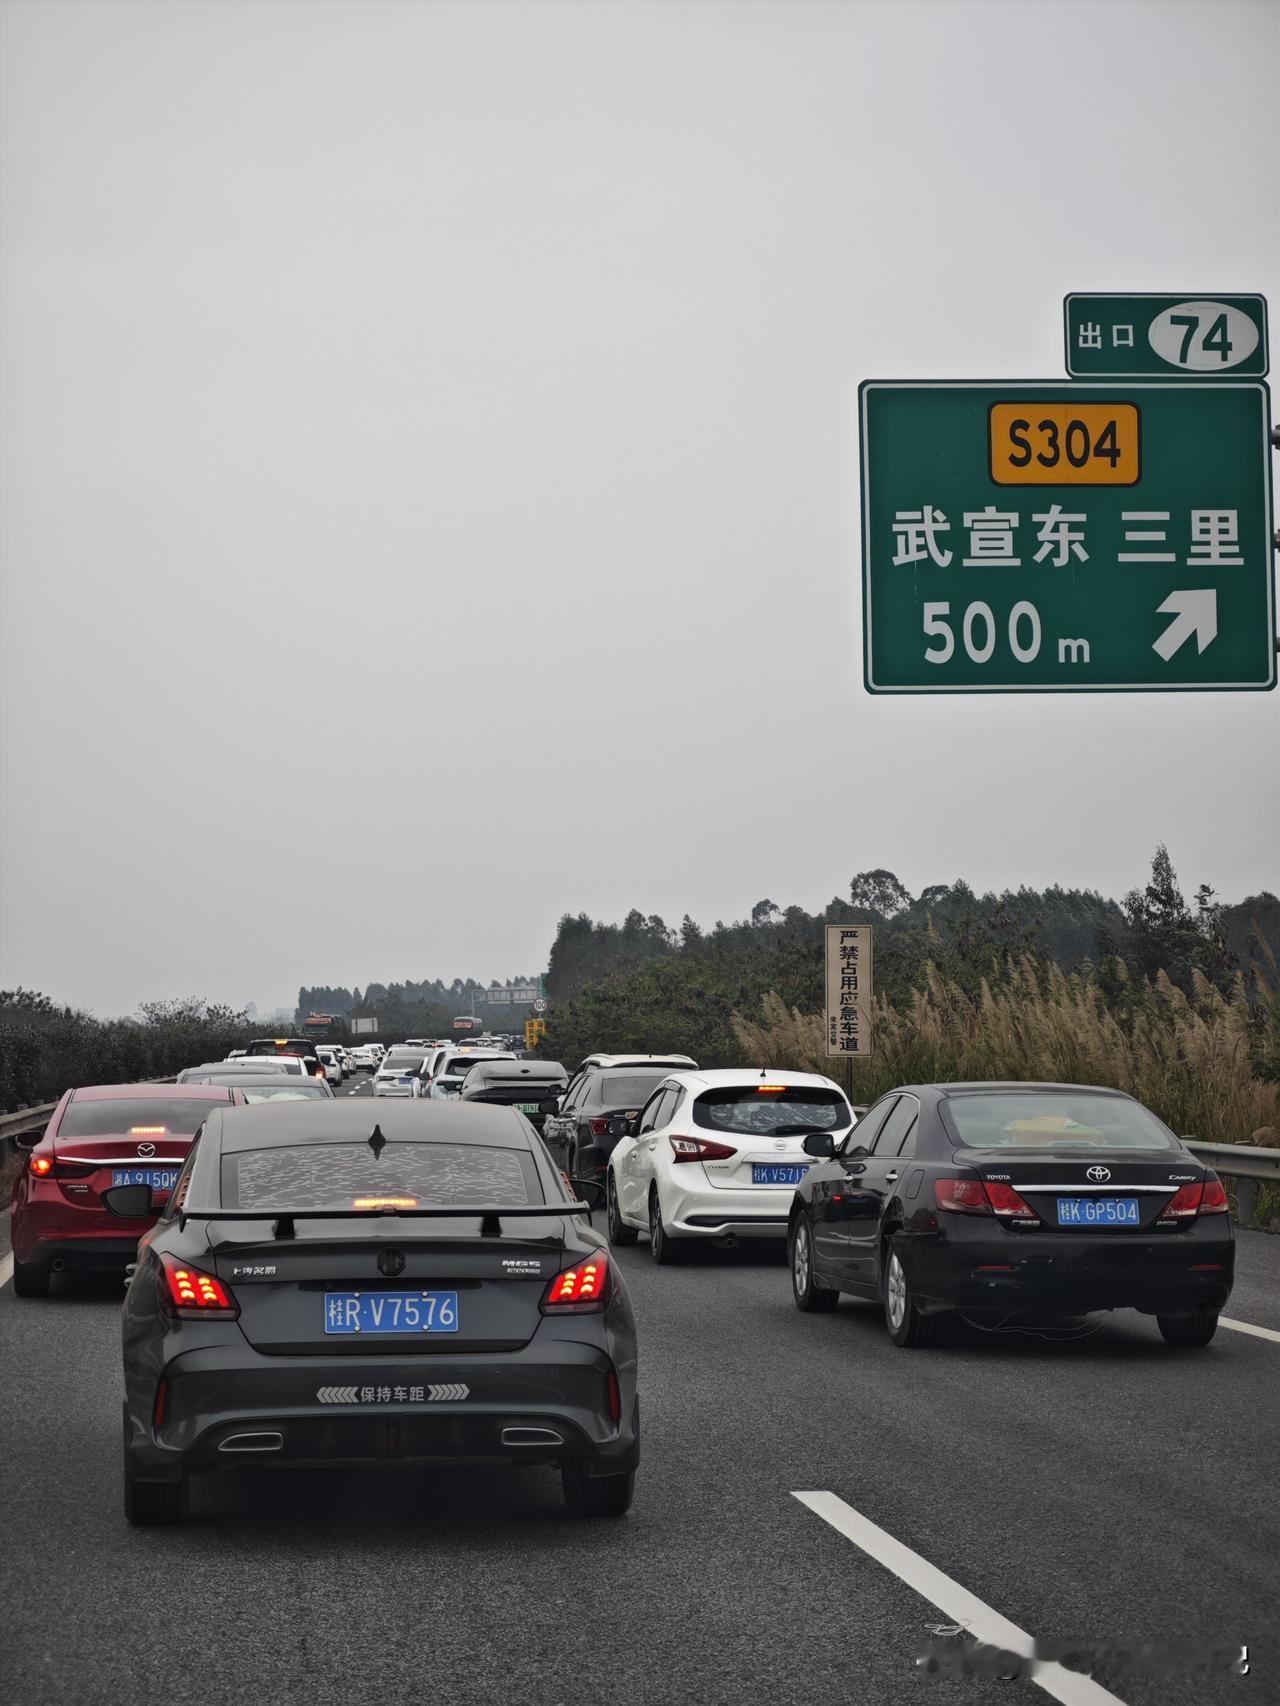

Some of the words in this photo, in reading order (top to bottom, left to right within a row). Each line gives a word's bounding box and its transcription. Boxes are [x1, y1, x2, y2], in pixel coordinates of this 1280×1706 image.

[1078, 322, 1135, 349] 出口
[1169, 313, 1233, 364] 74
[1008, 419, 1121, 468] S304
[892, 504, 1090, 568] 武宣东
[1117, 509, 1245, 566] 三里
[923, 600, 1042, 664] 500
[1058, 637, 1090, 663] m
[840, 930, 859, 1051] 严禁占用应急车道
[360, 1386, 425, 1403] 保持车距
